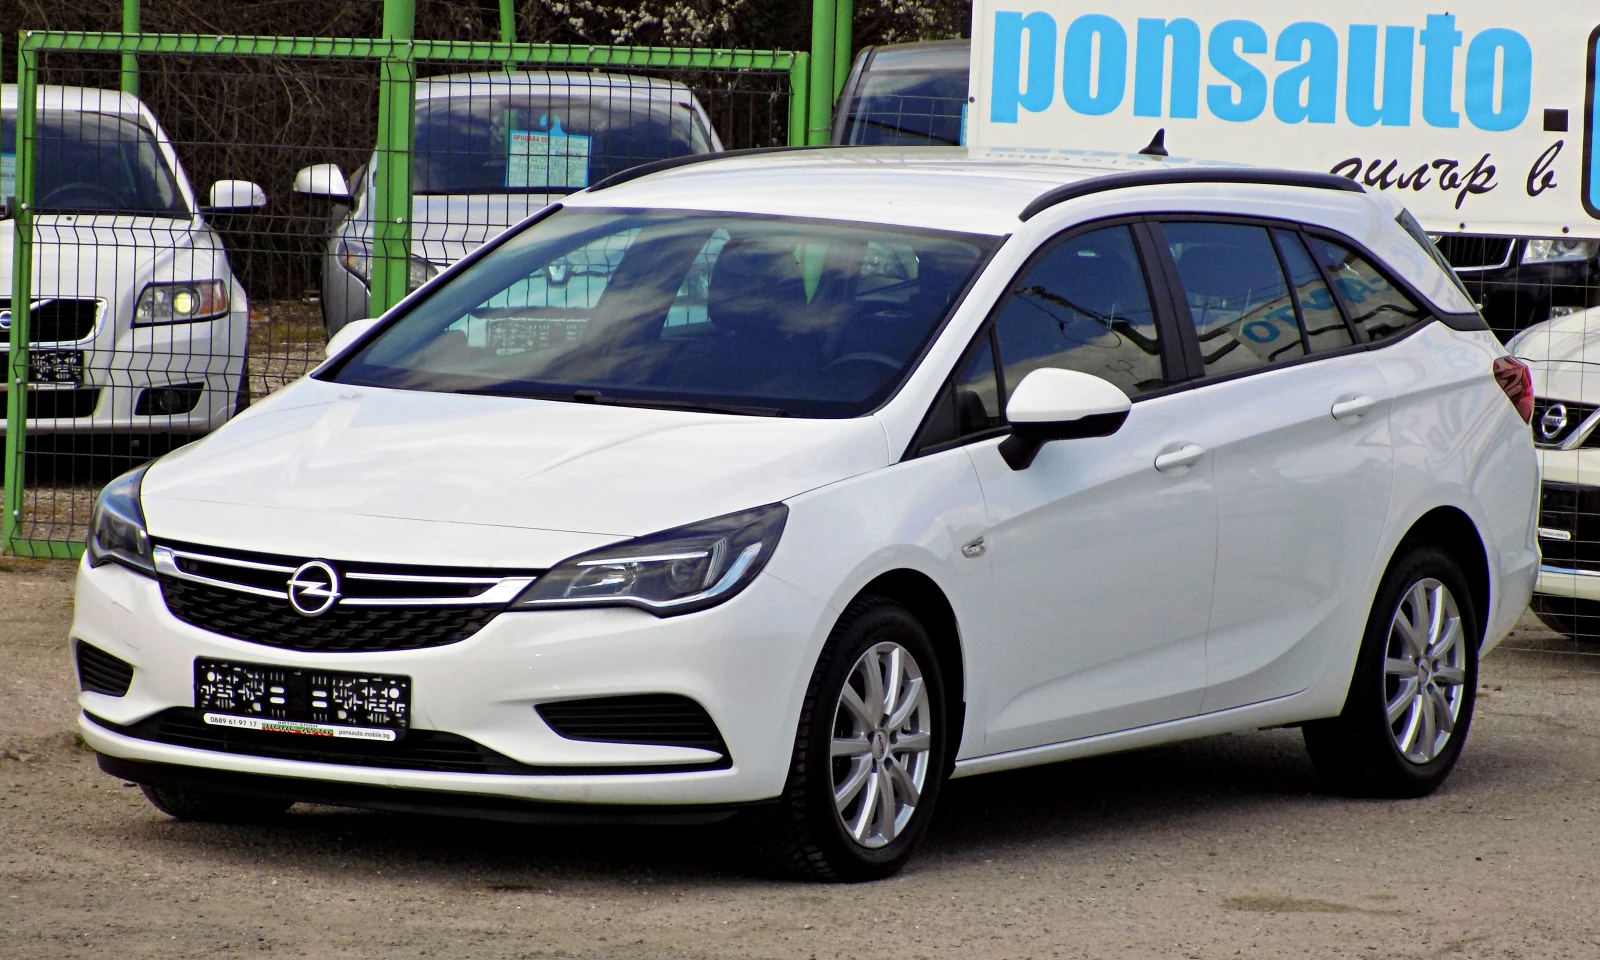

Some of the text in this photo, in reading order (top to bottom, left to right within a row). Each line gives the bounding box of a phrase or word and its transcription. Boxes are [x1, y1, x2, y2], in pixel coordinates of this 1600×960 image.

[1526, 139, 1564, 197] в
[210, 716, 227, 724] 0889
[338, 729, 391, 740] ponsauto.mobile.bg
